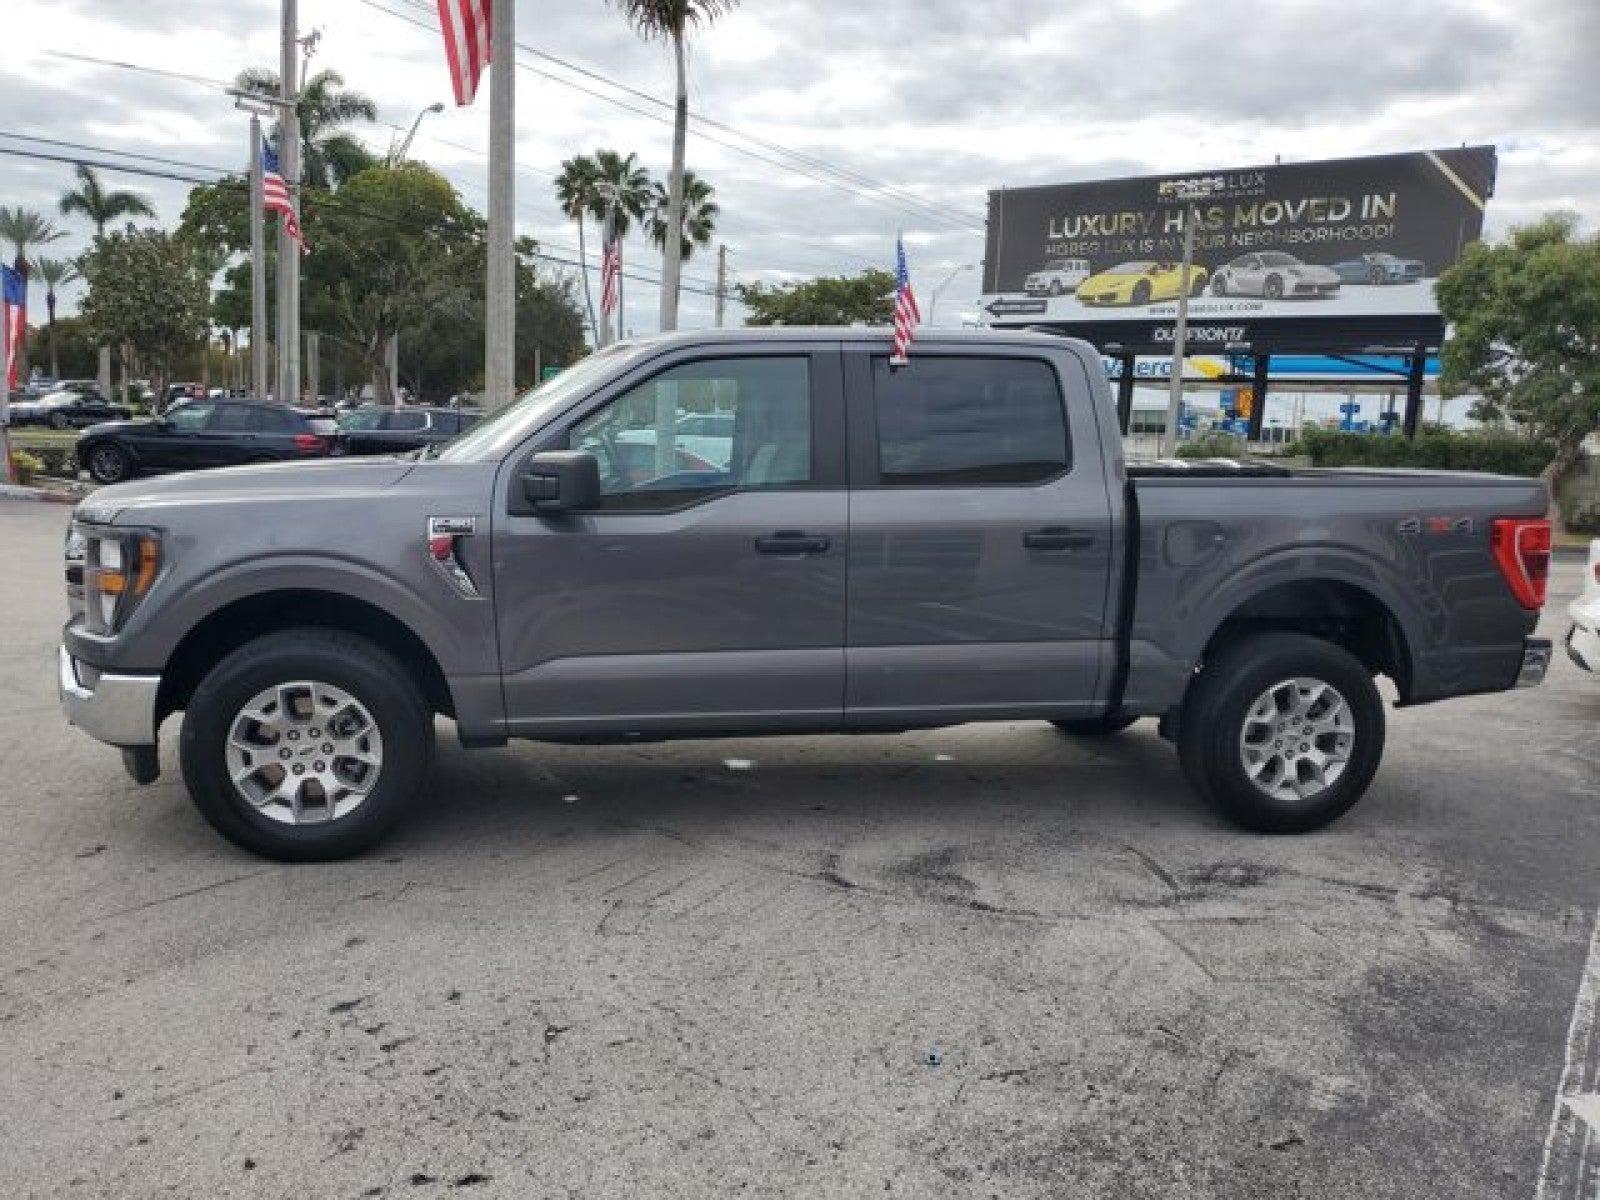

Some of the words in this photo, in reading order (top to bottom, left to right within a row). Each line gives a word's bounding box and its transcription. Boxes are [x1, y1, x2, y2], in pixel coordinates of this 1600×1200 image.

[1049, 208, 1156, 239] LUXURY
[1164, 205, 1224, 235] HAS
[1233, 198, 1350, 229] MOVED
[1361, 191, 1397, 221] IN
[1232, 224, 1394, 247] NEIGHBORHOOD!
